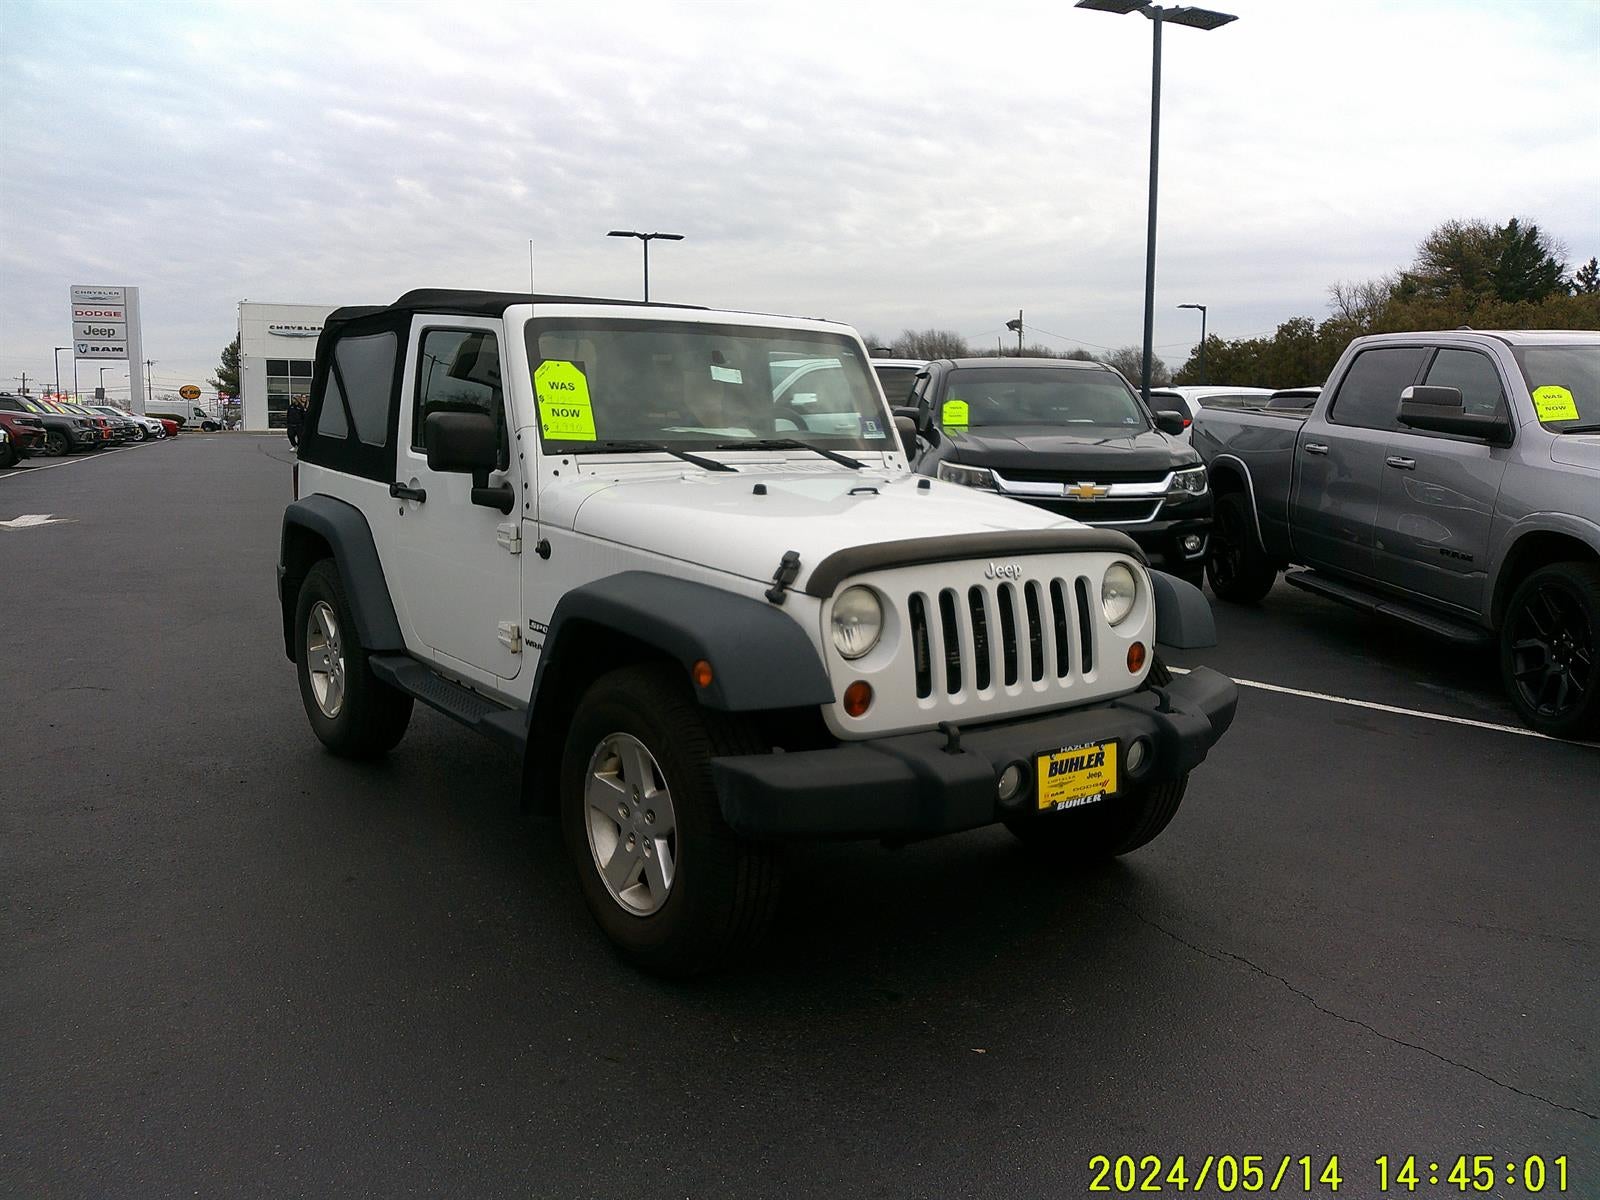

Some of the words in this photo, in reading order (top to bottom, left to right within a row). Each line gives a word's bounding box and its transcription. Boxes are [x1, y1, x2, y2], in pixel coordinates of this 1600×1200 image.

[83, 325, 116, 338] Jeep
[548, 381, 576, 391] WAS
[551, 408, 580, 418] NOW
[984, 562, 1022, 581] Jeep
[1060, 741, 1096, 752] HAZLET
[1048, 751, 1105, 778] BUHLER
[1086, 771, 1103, 780] Jeep
[1050, 790, 1065, 798] RAM
[1057, 794, 1102, 811] BUHLER
